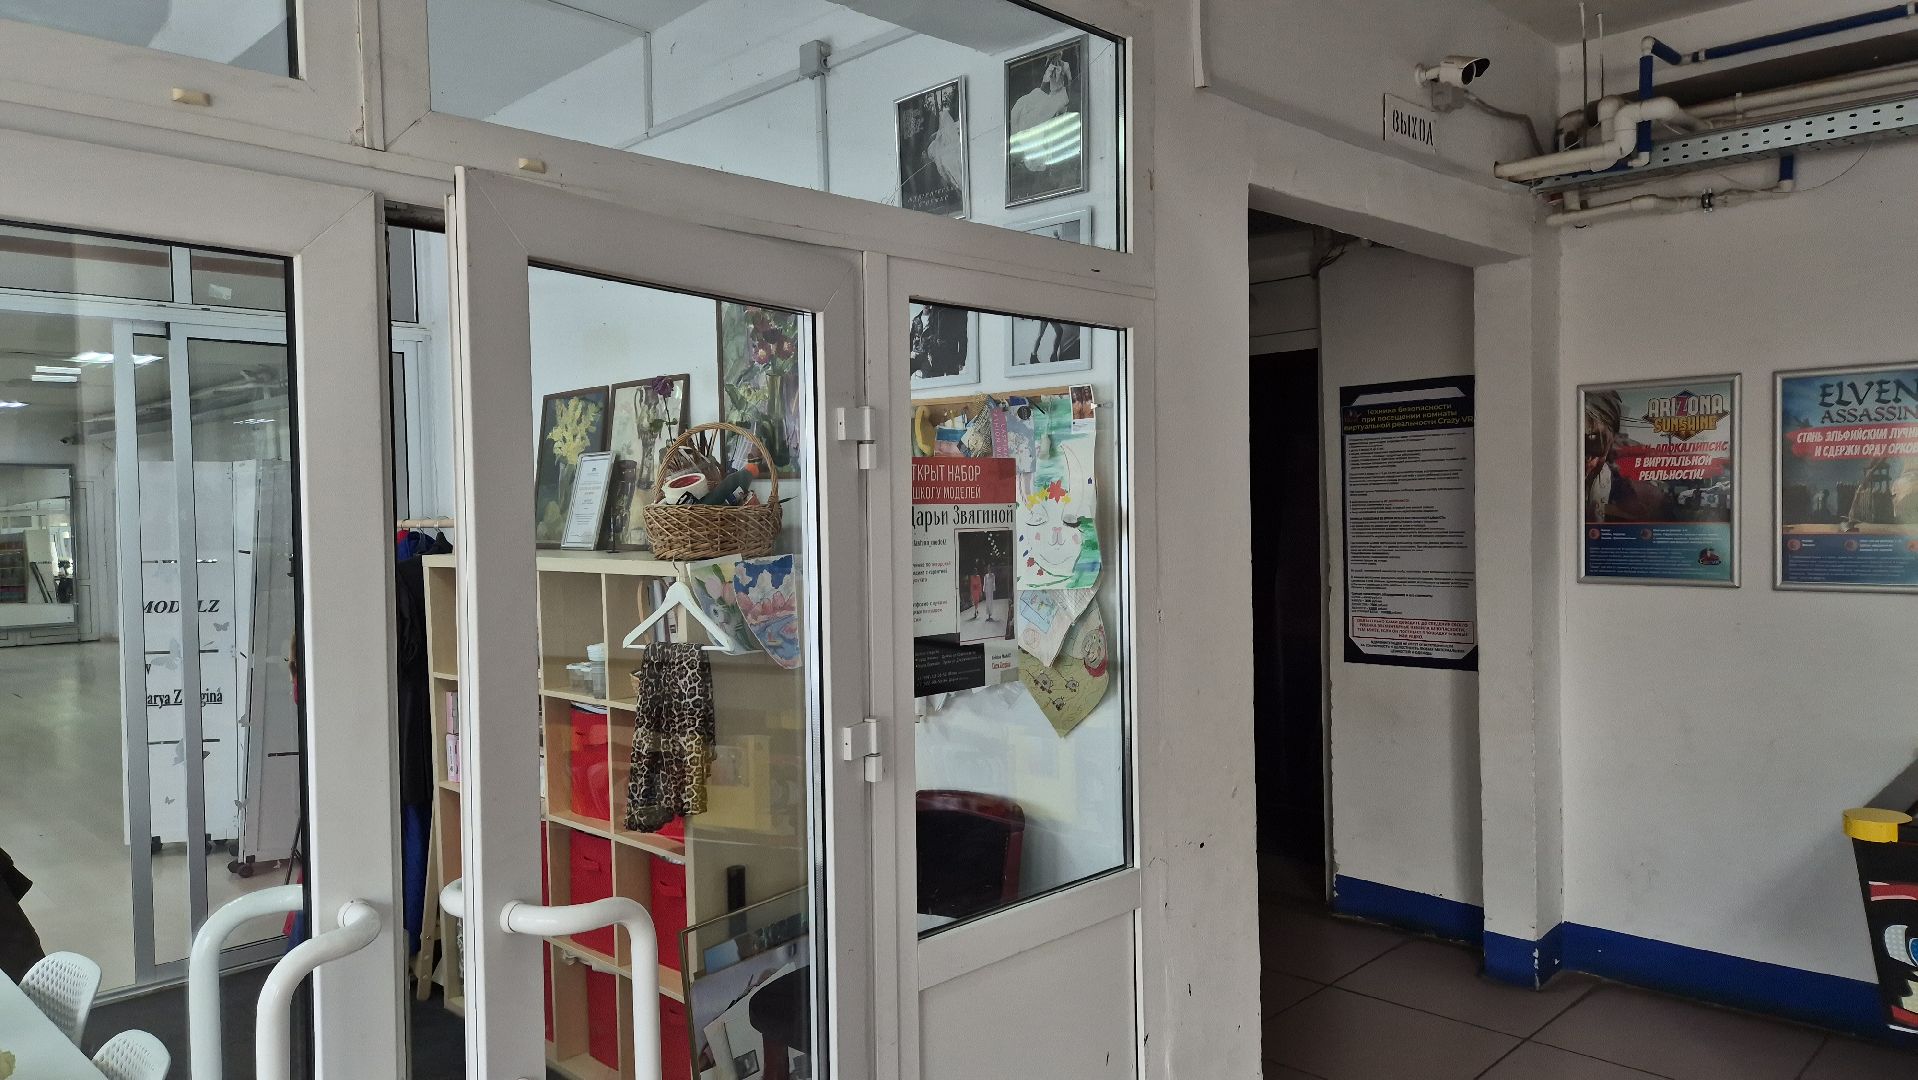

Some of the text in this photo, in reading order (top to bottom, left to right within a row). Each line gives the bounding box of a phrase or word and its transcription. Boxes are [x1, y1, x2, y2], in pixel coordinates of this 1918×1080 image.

[1392, 109, 1433, 146] ВЫХОД
[1818, 378, 1918, 407] ELVEN
[1649, 394, 1723, 417] ARIZONA
[1422, 410, 1458, 418] комнаты
[1437, 417, 1460, 425] Crazy
[1461, 415, 1474, 423] VR
[1653, 415, 1717, 433] SUNSHINE
[1797, 431, 1823, 443] СТАНЬ
[1814, 446, 1821, 457] И
[1823, 444, 1860, 457] СДЕРЖИ
[1862, 443, 1887, 456] ОРДУ
[1634, 457, 1641, 468] В
[912, 464, 981, 482] ТКРЫТ НАБОР
[1639, 469, 1705, 480] РЕАЛЬНОСТИ!
[943, 485, 981, 500] МОДЕЛЕЙ
[953, 505, 1013, 525] Звягиной
[143, 600, 220, 613] MODLZ
[147, 694, 171, 709] arya
